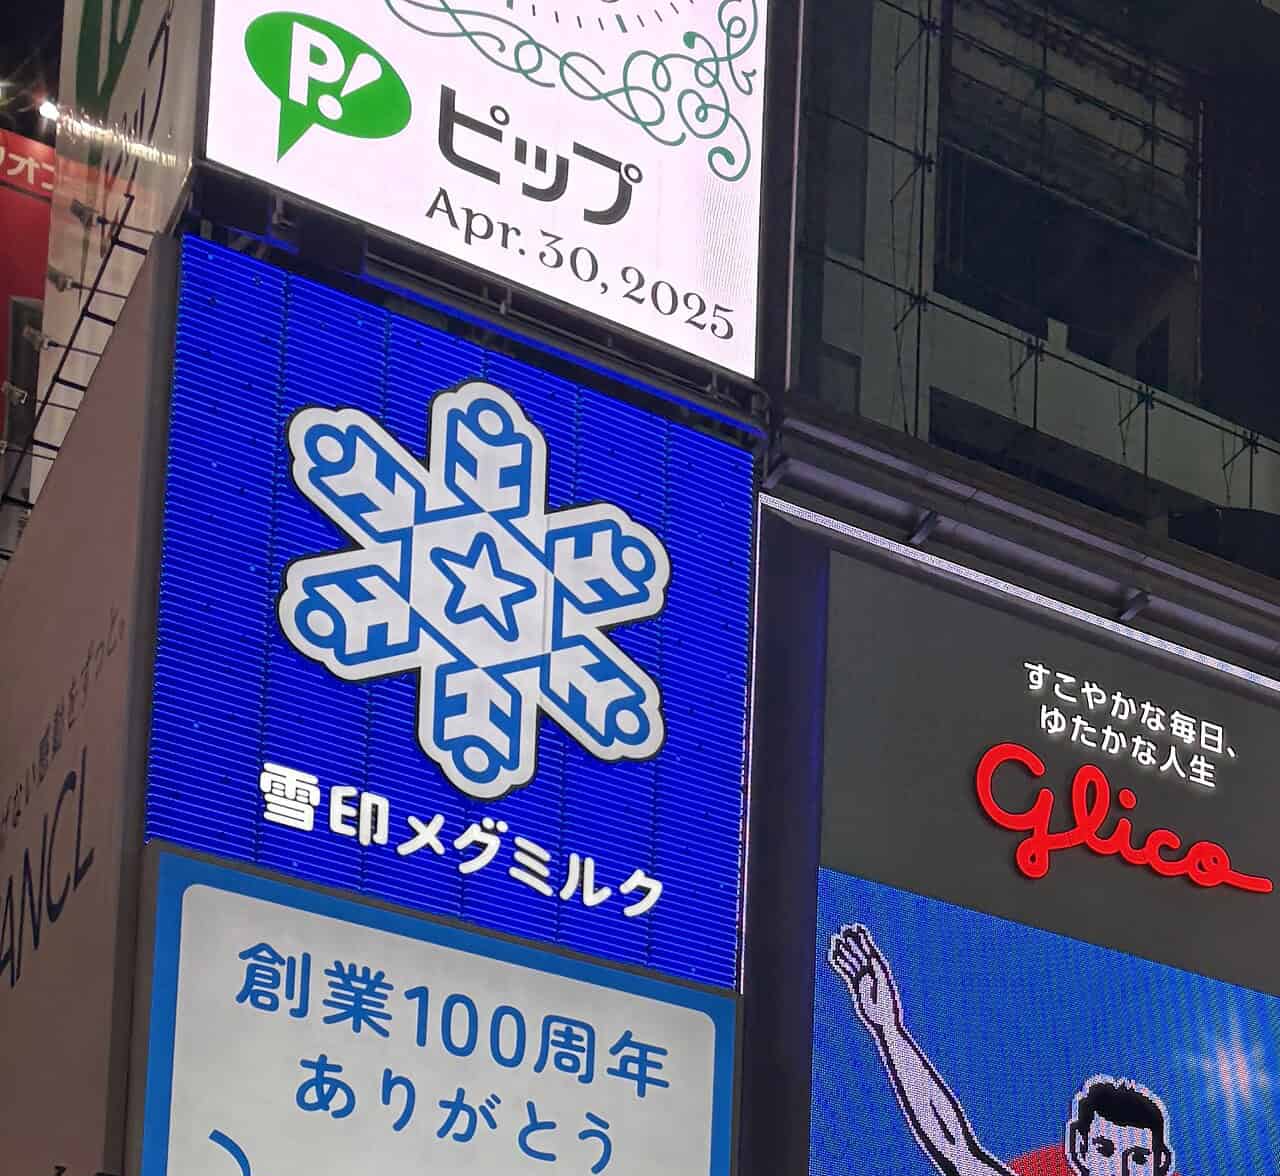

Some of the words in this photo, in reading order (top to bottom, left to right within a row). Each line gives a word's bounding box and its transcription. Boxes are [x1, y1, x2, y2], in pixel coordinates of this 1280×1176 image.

[438, 84, 643, 226] ピップ
[426, 187, 526, 256] Apr.
[1023, 661, 1237, 758] すこやかな毎日、
[1039, 703, 1216, 788] ゆたかな人生
[259, 761, 664, 917] 雪印メグミルク
[235, 941, 671, 1098] 創業100周年
[295, 1054, 613, 1175] ありがとう
